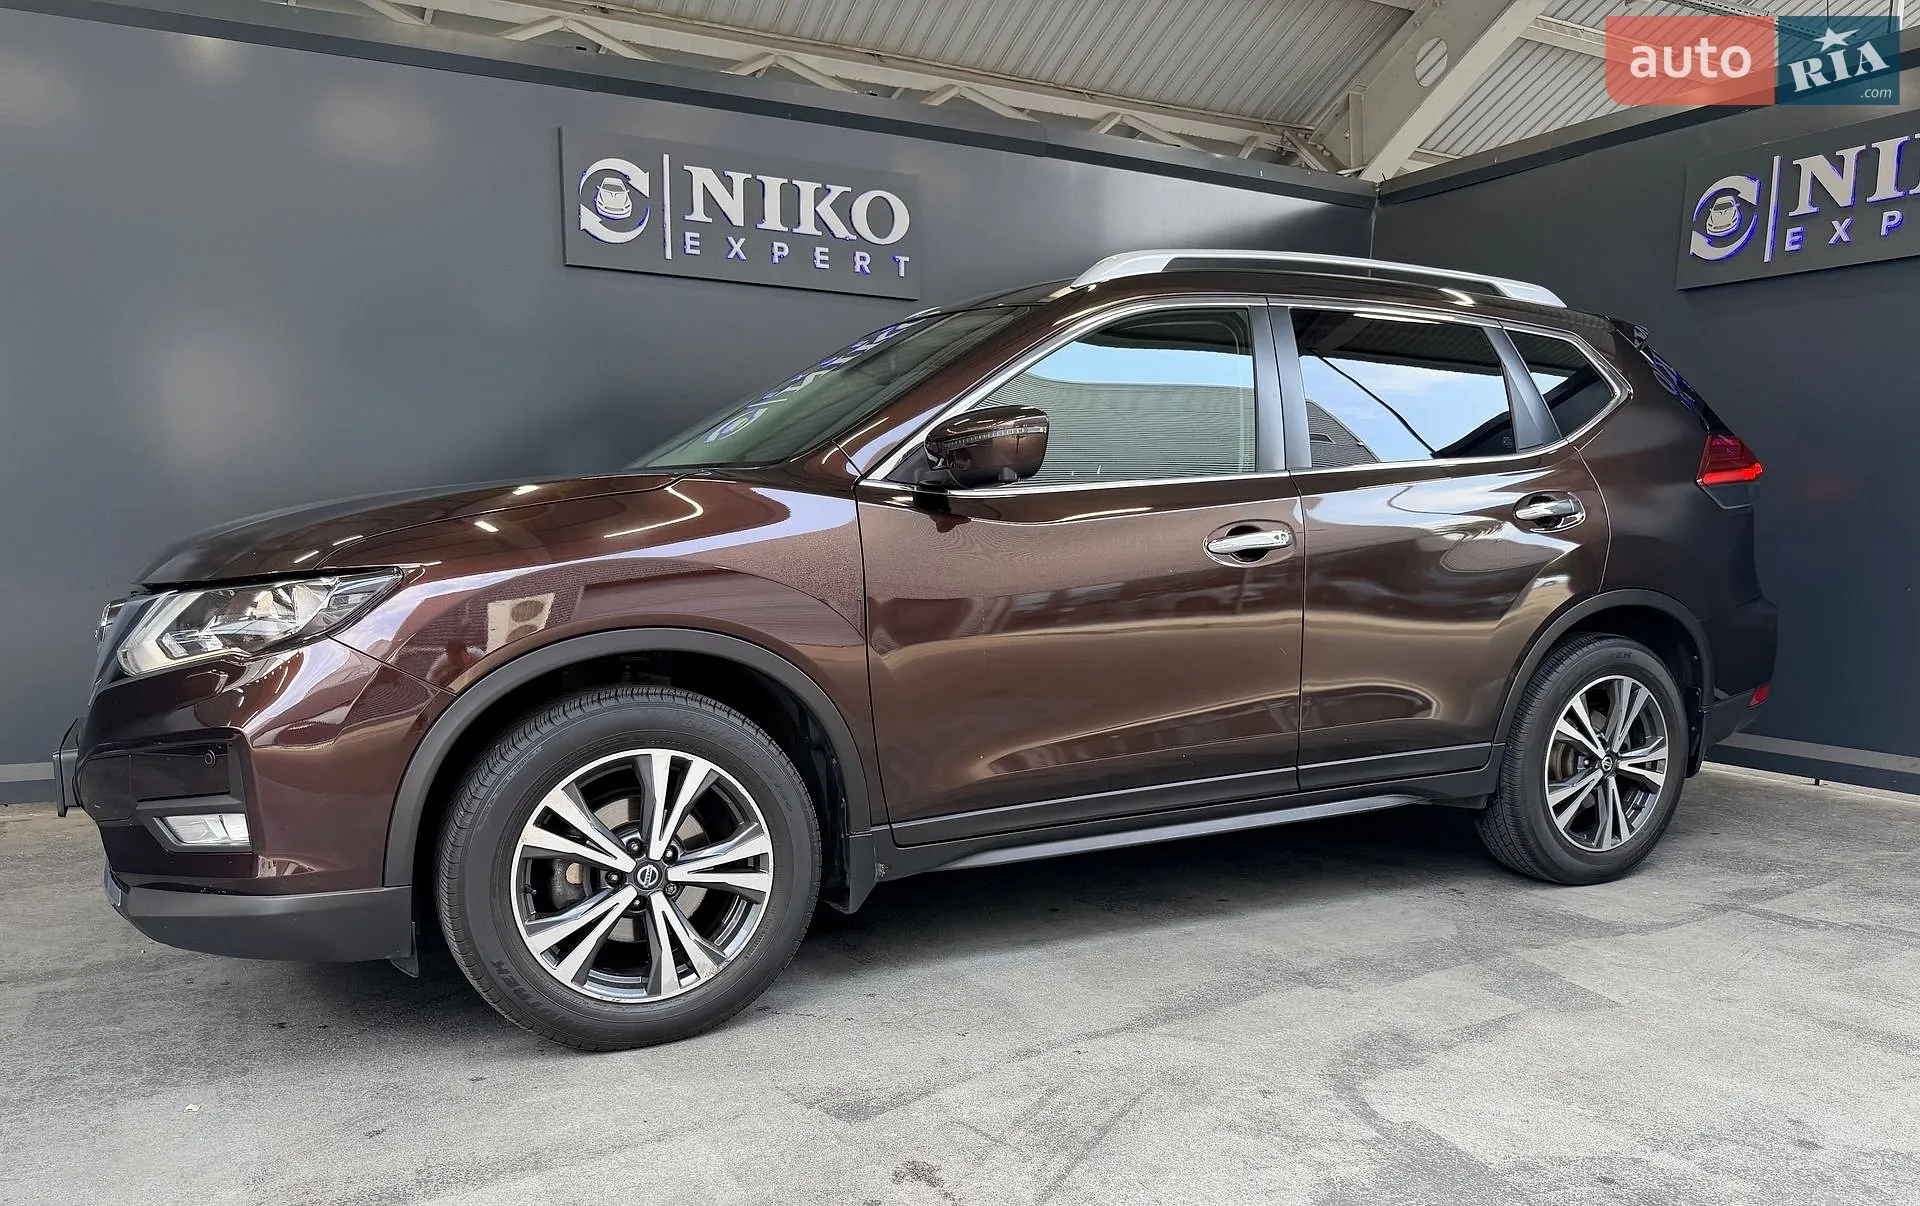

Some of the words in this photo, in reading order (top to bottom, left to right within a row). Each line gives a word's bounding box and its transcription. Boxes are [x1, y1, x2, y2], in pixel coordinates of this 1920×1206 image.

[683, 165, 910, 245] NIKO
[1789, 134, 1920, 217] NI
[684, 231, 910, 277] EXPERT
[1784, 210, 1904, 252] EXP
